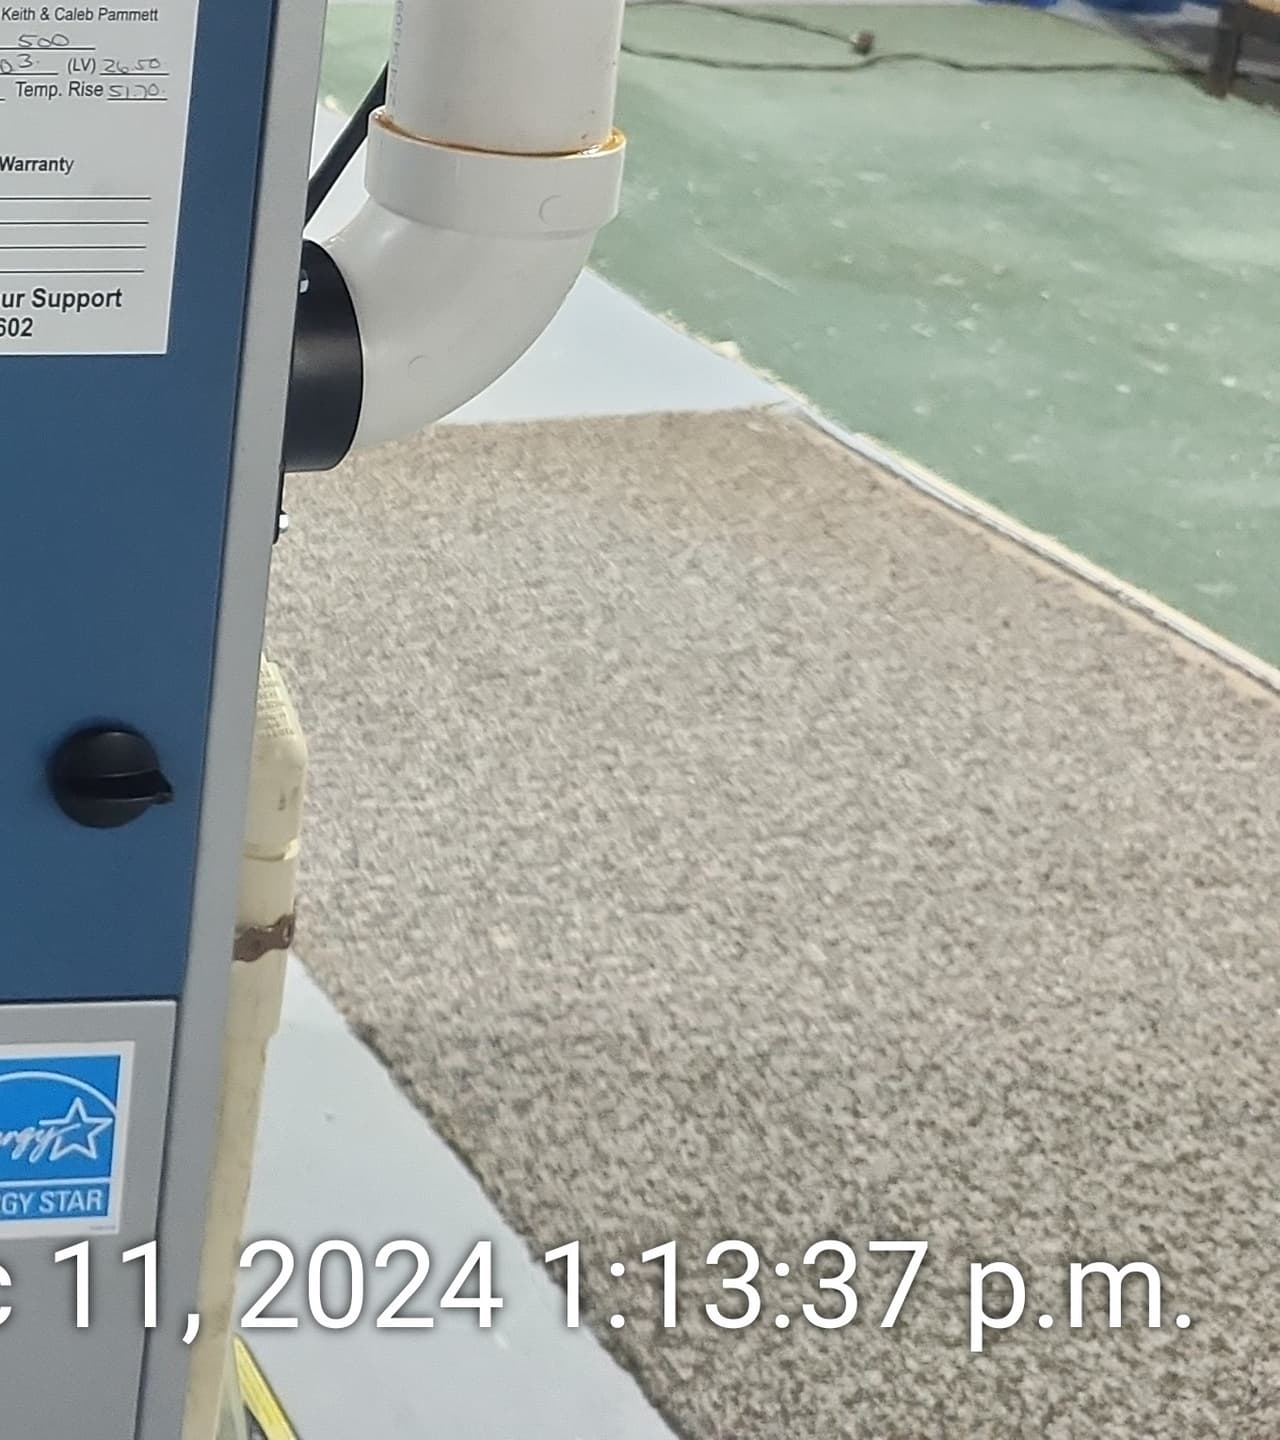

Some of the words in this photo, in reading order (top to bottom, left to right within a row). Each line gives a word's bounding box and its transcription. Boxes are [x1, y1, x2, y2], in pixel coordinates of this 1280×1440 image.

[1, 7, 36, 21] Keith
[40, 7, 50, 21] &
[54, 7, 94, 21] Caleb
[98, 7, 159, 21] Pammett
[67, 58, 97, 75] (LV)
[16, 81, 62, 100] Temp.
[68, 81, 104, 97] Rise
[0, 156, 75, 175] Warranty
[31, 288, 123, 312] Support
[39, 1189, 103, 1213] STAR
